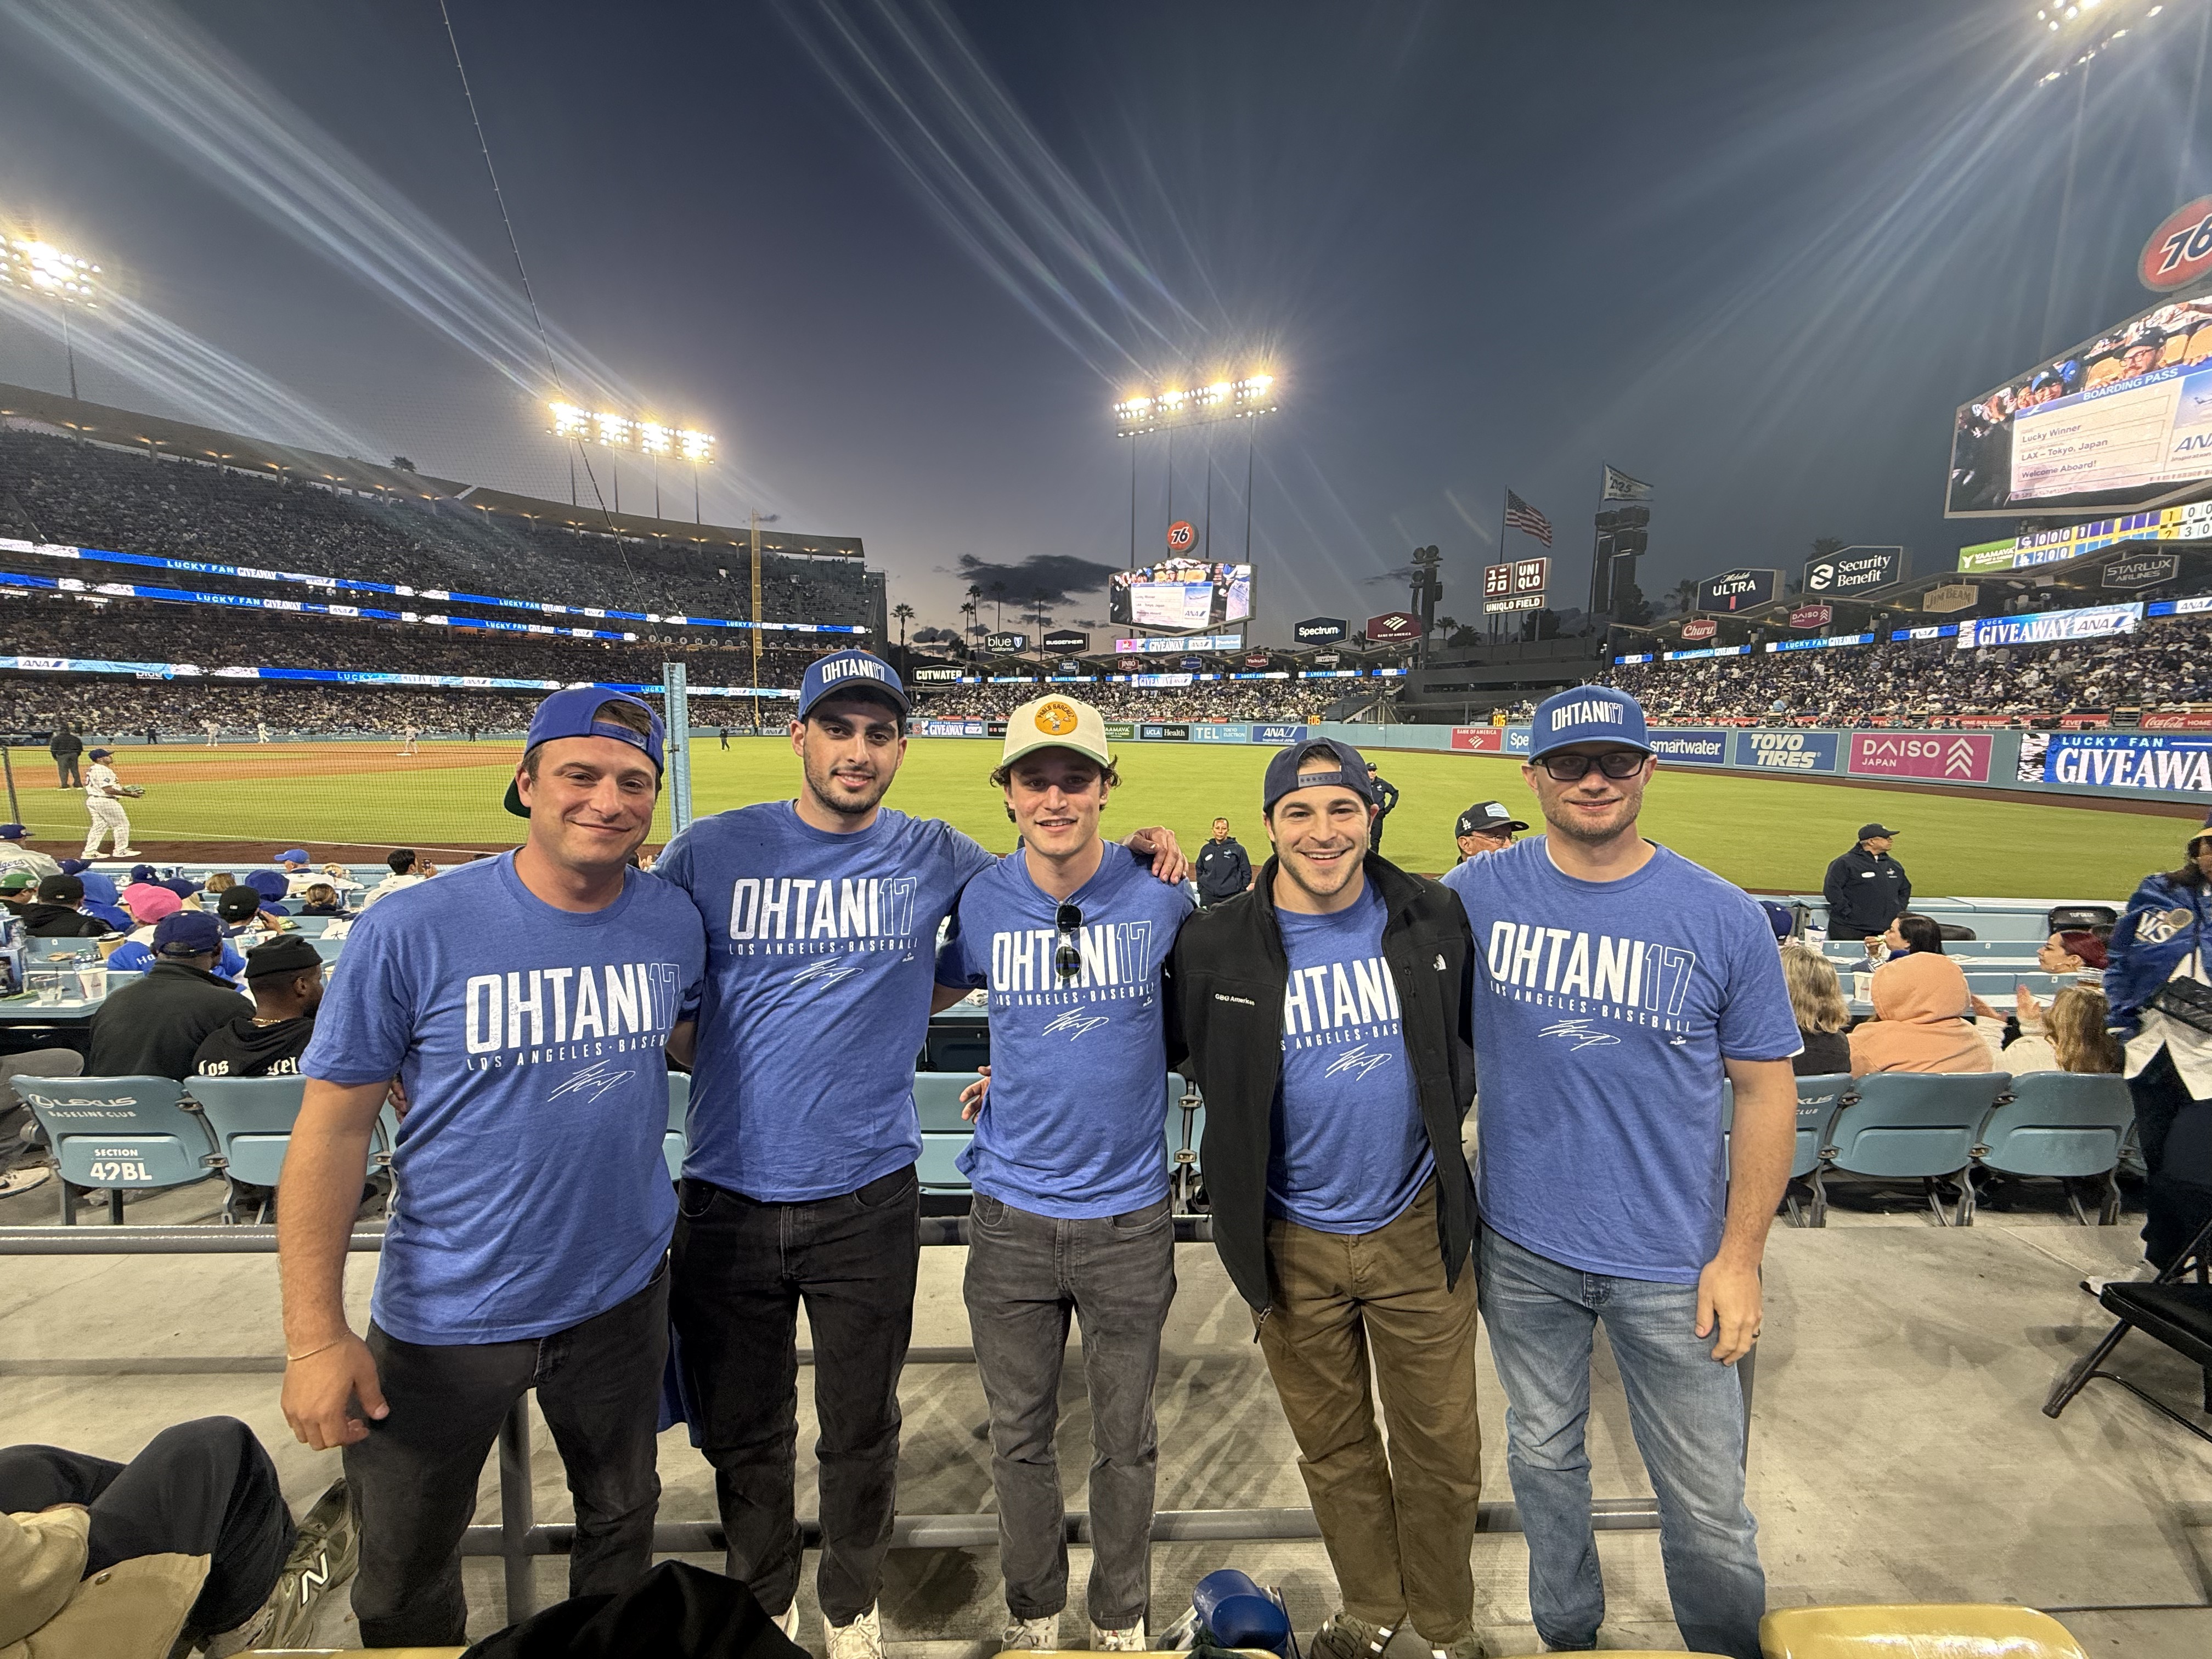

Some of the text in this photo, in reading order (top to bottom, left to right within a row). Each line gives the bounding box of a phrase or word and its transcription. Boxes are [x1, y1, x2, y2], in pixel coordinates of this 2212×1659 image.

[2157, 212, 2212, 275] 76
[2083, 368, 2179, 400] BOARDING PASS
[2022, 424, 2081, 443] Lucky Winner
[2022, 452, 2038, 461] LAX
[2048, 446, 2075, 456] Tokyo,
[2078, 439, 2108, 450] Japan
[2022, 460, 2097, 478] Welcome Aboard!
[2039, 534, 2046, 545] 0
[2051, 531, 2058, 543] 0
[2062, 529, 2070, 540] 0
[2080, 526, 2086, 538] 1
[2169, 511, 2174, 522] 1
[2188, 506, 2195, 518] 0
[1171, 526, 1189, 544] 76
[2036, 551, 2044, 562] 2
[2049, 549, 2056, 560] 0
[2060, 548, 2068, 558] 0
[2185, 526, 2192, 537] 3
[2202, 523, 2210, 534] 0
[167, 560, 276, 580] LUCKY FAN GIVEAWAY
[1519, 563, 1539, 577] UNI
[1838, 555, 1892, 574] Security
[2107, 558, 2172, 577] STARLUX
[1518, 575, 1541, 590] QLO
[1837, 571, 1882, 587] Benefit
[2115, 569, 2161, 582] AIRLINES
[1713, 579, 1756, 596] ULTRA
[196, 593, 302, 611] LUCKY FAN GIVEAWAY
[499, 599, 523, 608] LUCKY
[1486, 597, 1541, 612] UNIQLO FIELD
[1926, 588, 1971, 608] JIM BEAM
[2180, 601, 2203, 610] ANA
[1792, 611, 1818, 620] DAISO
[486, 620, 511, 629] LUCKY
[1299, 626, 1339, 637] Spectrum
[1683, 625, 1714, 637] Churu
[1978, 617, 2073, 646] GIVEAWAY
[2076, 618, 2110, 631] ANA
[988, 636, 1012, 647] blue
[1149, 640, 1185, 652] GIVEAWAY
[1785, 640, 1809, 649] LUCKY
[22, 659, 50, 668] ANA
[337, 673, 372, 681] LUCKY
[1037, 704, 1052, 718] PABLO
[929, 724, 964, 736] GIVEAWAY
[1164, 728, 1185, 737] Health
[1195, 727, 1219, 740] TEL
[1263, 727, 1285, 737] ANA
[1510, 732, 1529, 749] Spe
[1650, 738, 1721, 755] smartwater
[1750, 733, 1804, 751] TOYO
[1862, 739, 1940, 758] DAISO
[2062, 736, 2164, 747] LUCKY FAN
[1757, 750, 1817, 769] TIRES
[1861, 757, 1897, 768] JAPAN
[2055, 747, 2212, 791] GIVEAWA
[729, 937, 918, 956] LOS ANGELES BASEBALL
[1018, 991, 1079, 1006] ANGELES
[1284, 956, 1400, 1036] HTANI
[1490, 980, 1690, 1032] LOS ANGELES BASEBALL
[1296, 1028, 1361, 1049] ANGELES
[1373, 1023, 1398, 1039] BAS
[467, 1033, 669, 1071] LOS ANGELES BASEB
[53, 1097, 137, 1107] LEXUS
[90, 1162, 153, 1181] 42BL
